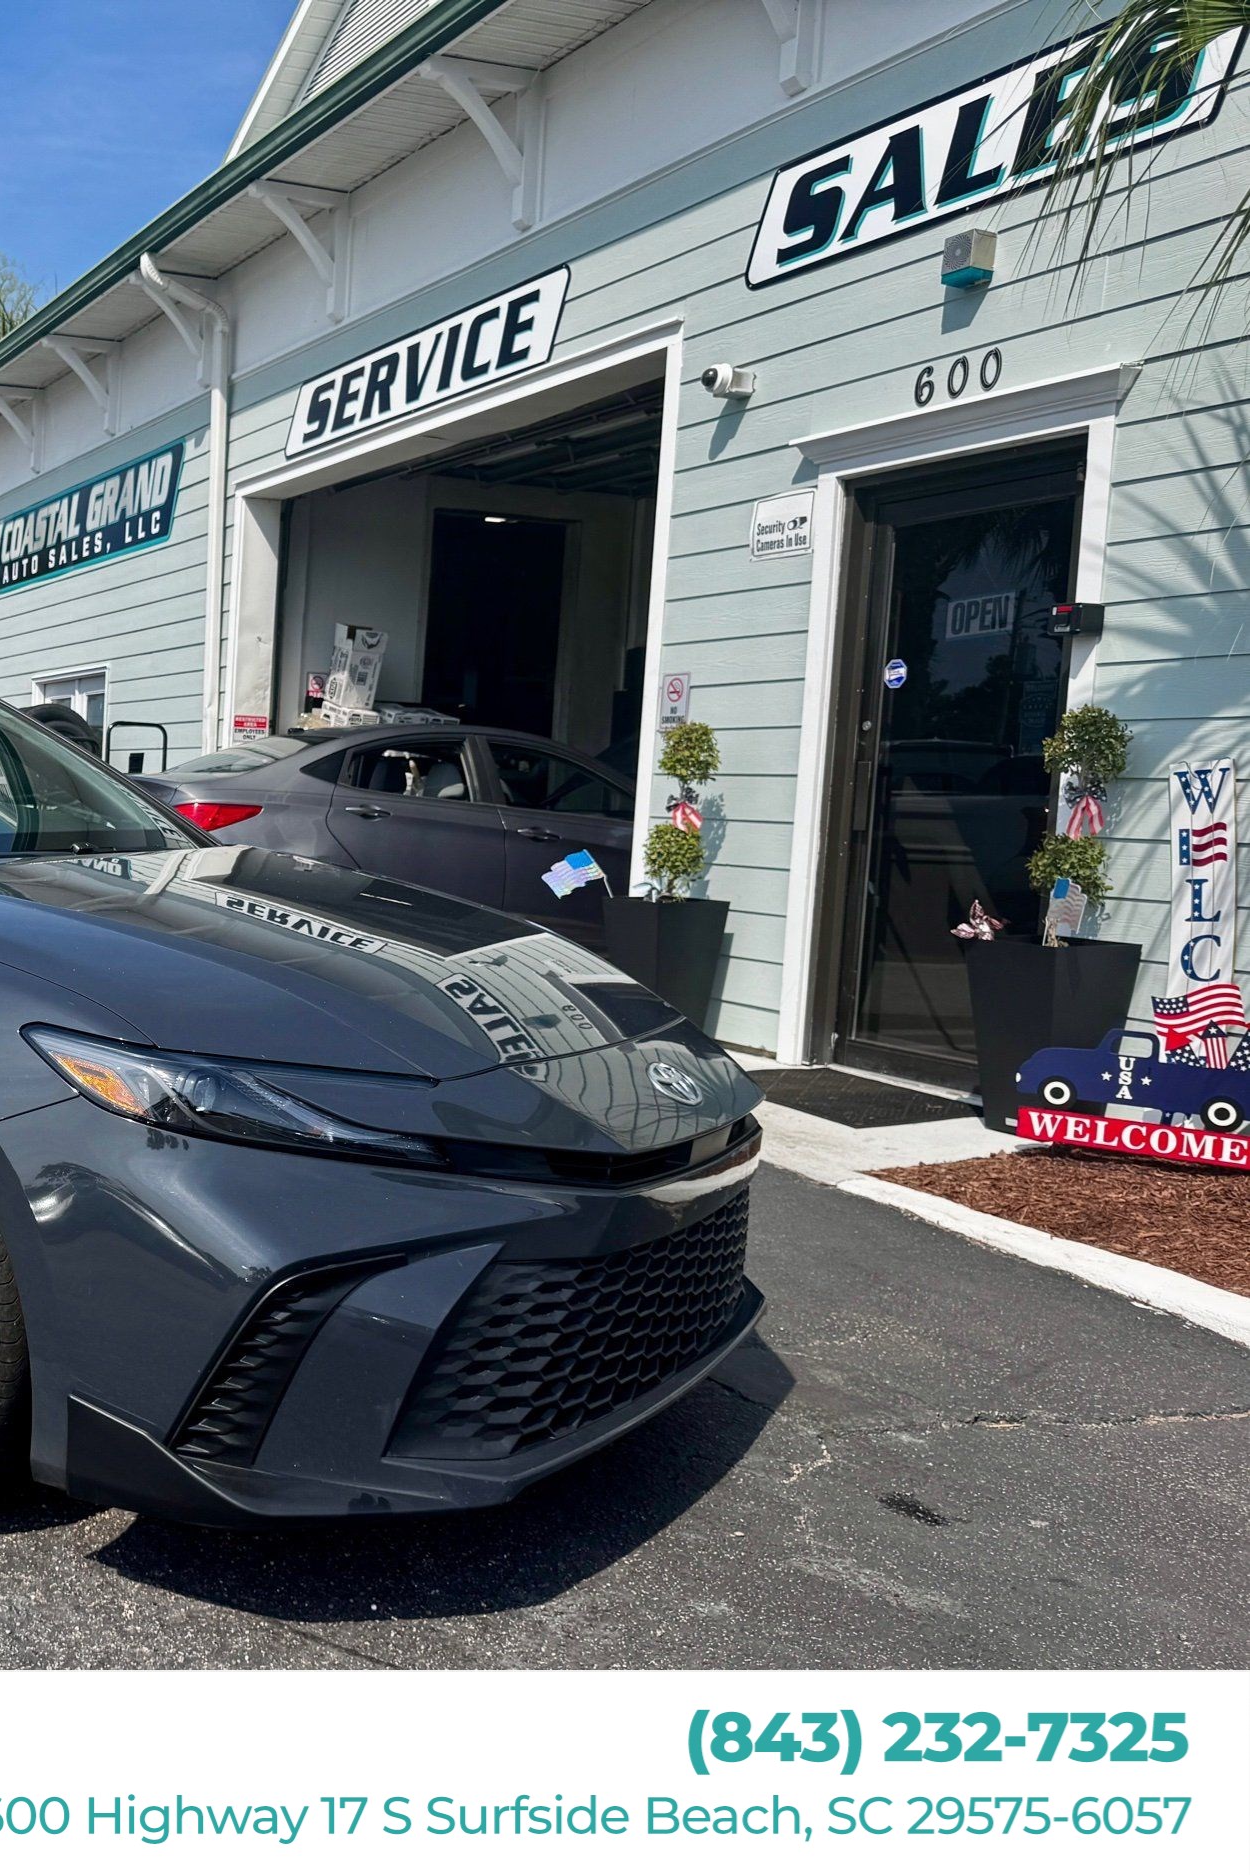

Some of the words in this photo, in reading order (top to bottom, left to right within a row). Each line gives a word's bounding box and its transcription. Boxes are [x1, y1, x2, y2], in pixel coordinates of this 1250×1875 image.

[301, 288, 541, 445] SERVICE
[913, 347, 1003, 407] 600
[1, 491, 81, 564] COASTAL
[85, 451, 173, 533] GRAND
[756, 520, 785, 537] Security
[2, 554, 39, 584] AUTO
[48, 531, 111, 569] SALES,
[124, 511, 161, 544] LLC
[756, 538, 784, 552] Cameras
[786, 535, 793, 548] In
[794, 533, 807, 547] Use
[951, 595, 1010, 635] OPEN
[670, 706, 678, 715] NO
[1115, 1056, 1136, 1100] USA
[1028, 1110, 1249, 1165] WELCOME
